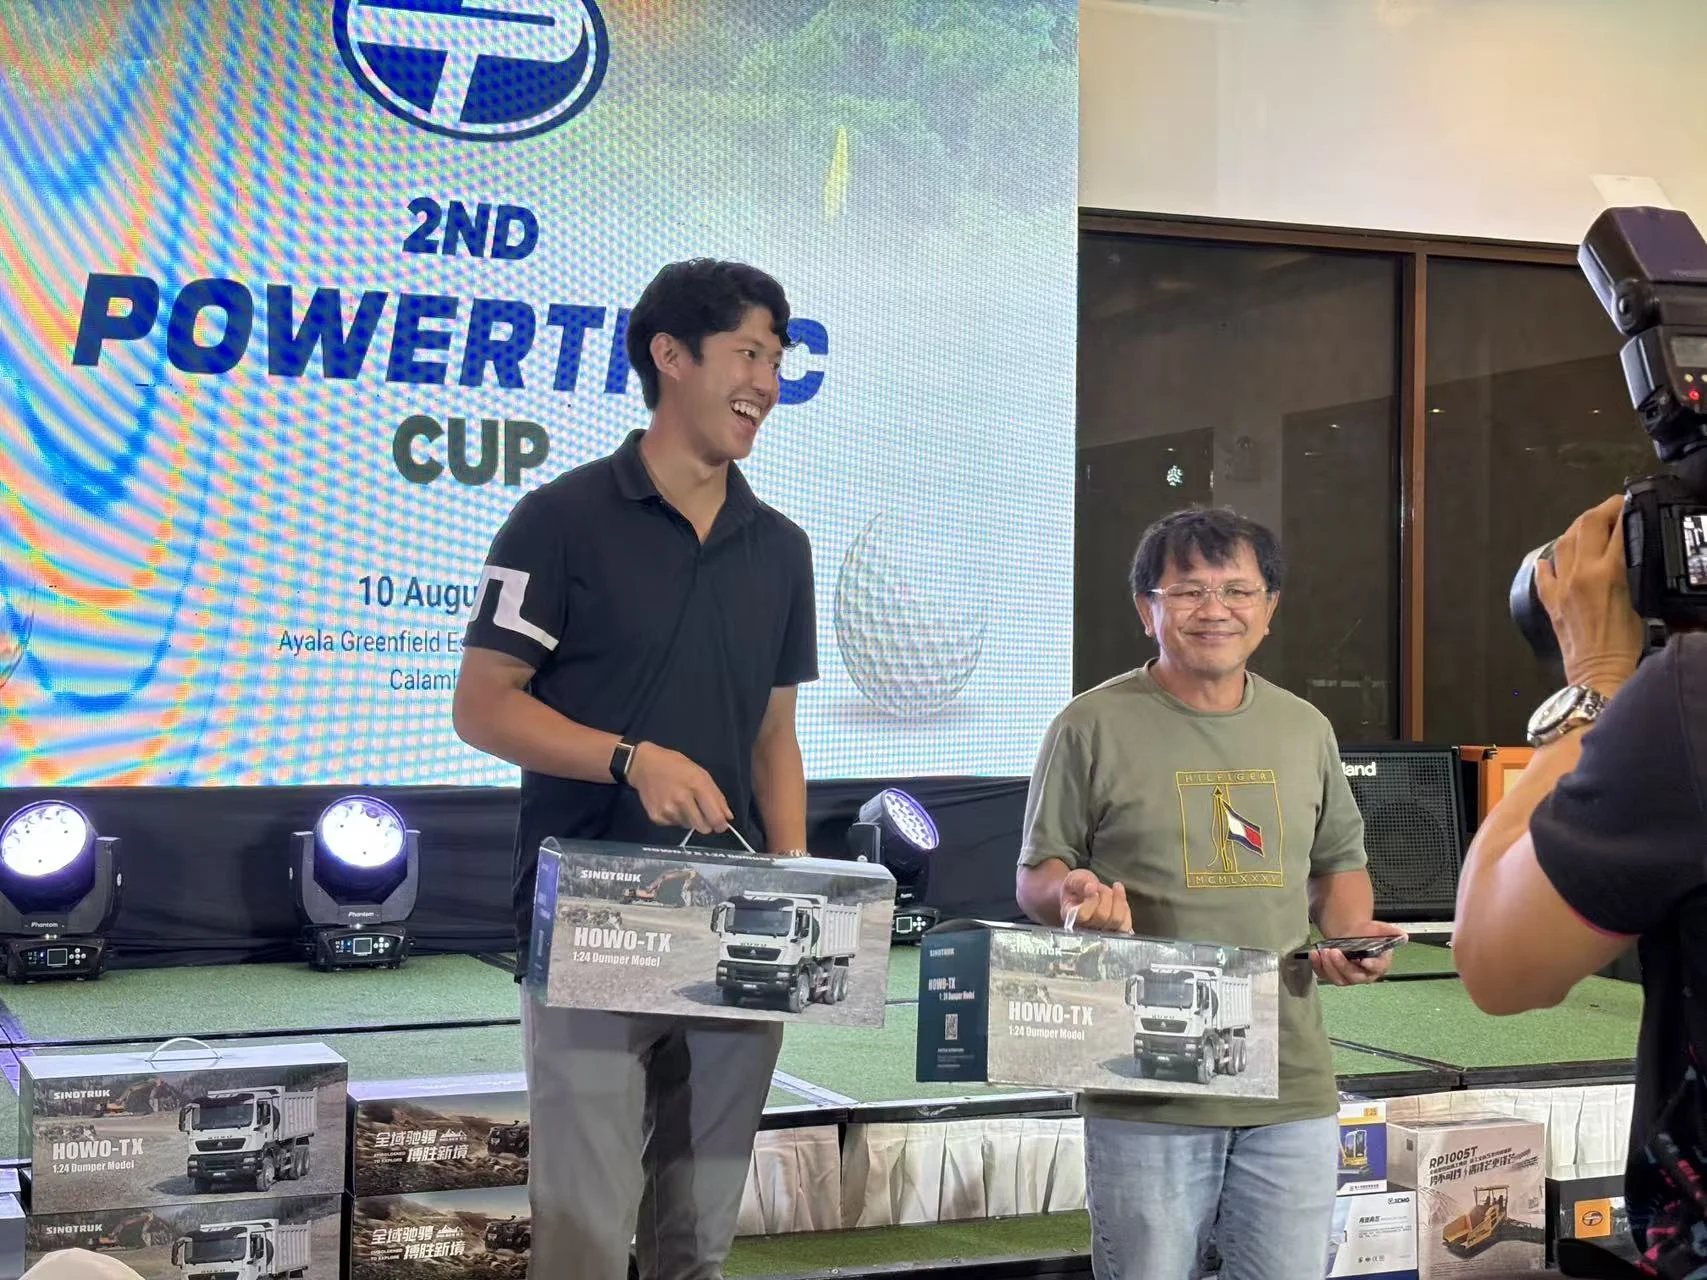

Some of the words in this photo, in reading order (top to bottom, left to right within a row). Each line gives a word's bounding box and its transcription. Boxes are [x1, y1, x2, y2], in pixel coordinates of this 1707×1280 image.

[402, 197, 539, 260] 2ND
[73, 272, 829, 405] POWERTC
[392, 414, 550, 486] CUP
[358, 575, 394, 607] 10
[404, 576, 478, 615] Augu
[279, 628, 334, 656] Ayala
[341, 629, 440, 652] Greenfield
[1184, 771, 1267, 783] HILFIGER
[580, 869, 642, 883] SINOTRUK
[574, 926, 672, 953] HOWO-TX
[572, 951, 591, 962] 1:24
[592, 952, 629, 965] Dumper
[631, 954, 661, 967] Model
[928, 976, 956, 991] HOWO-TX
[1008, 1000, 1094, 1026] HOWO-TX
[1008, 1024, 1025, 1037] 1:24
[1026, 1026, 1059, 1040] Dumper
[1059, 1028, 1085, 1041] Model
[53, 1089, 111, 1100] SINOTRUK
[374, 1129, 438, 1148] 全域驰骋
[52, 1138, 144, 1160] HOWO-TX
[1429, 1145, 1478, 1169] RP1005T
[52, 1163, 70, 1174] 1:24
[71, 1162, 106, 1173] Dumper
[107, 1159, 135, 1171] Model
[45, 1223, 103, 1235] SINOTRUK
[370, 1225, 434, 1245] 全域驰骋
